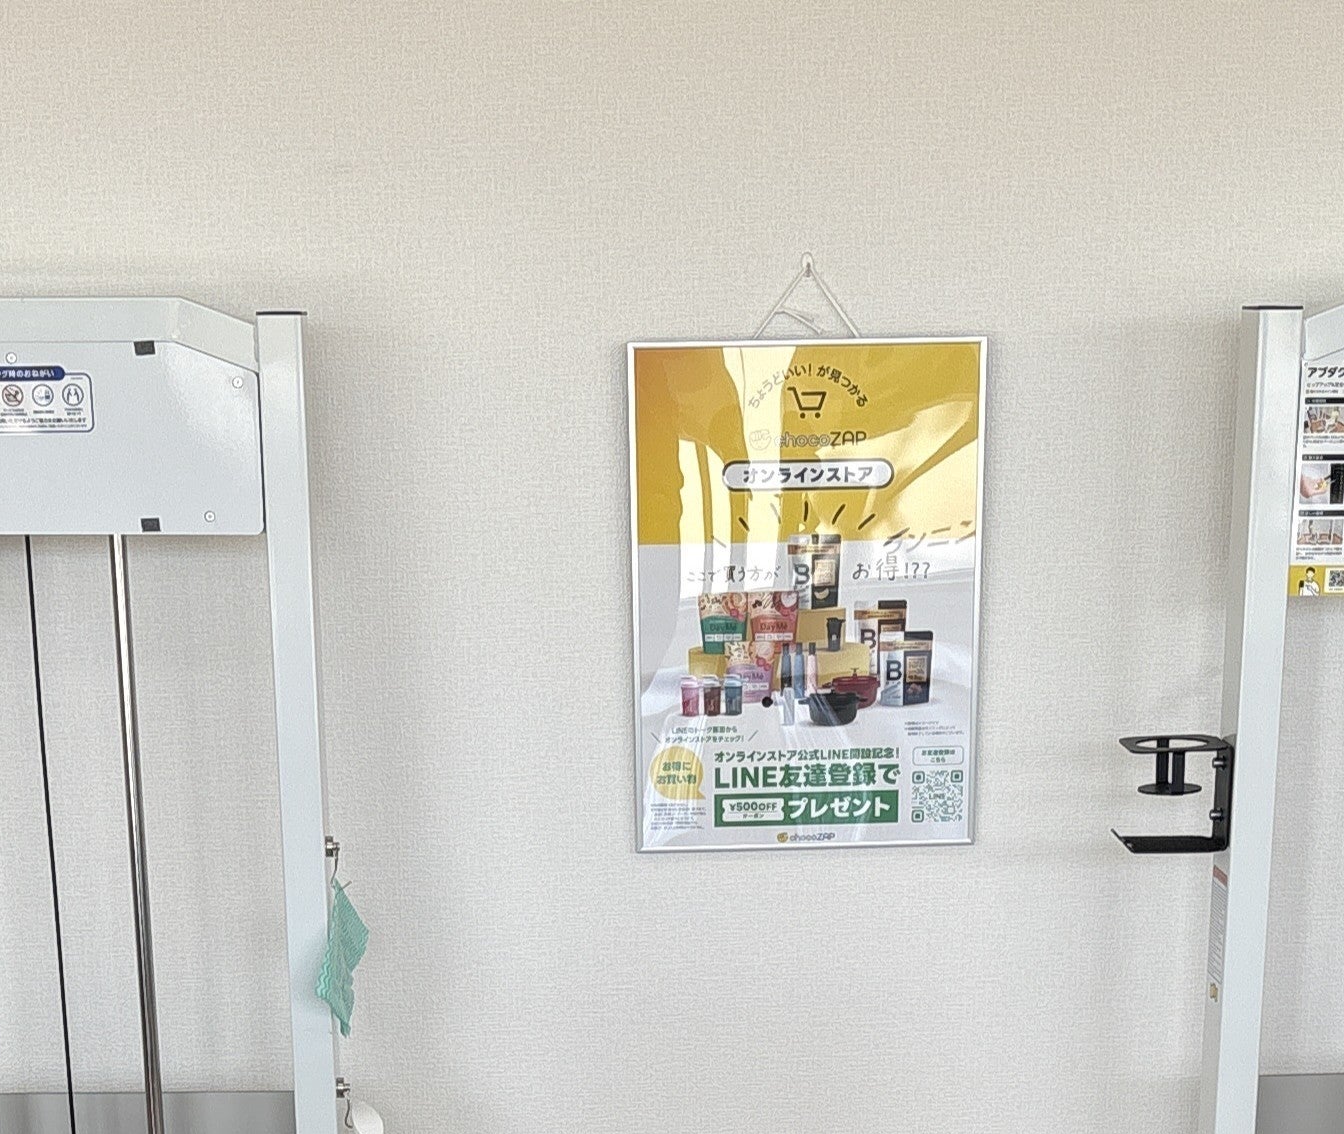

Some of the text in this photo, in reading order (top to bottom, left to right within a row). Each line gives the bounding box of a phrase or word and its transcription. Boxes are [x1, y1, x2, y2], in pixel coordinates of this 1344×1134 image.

[776, 431, 867, 447] chocoZAP
[743, 465, 873, 484] オンラインストア
[886, 660, 902, 681] B
[714, 747, 899, 763] オンラインストア公式LINE開設記念！
[662, 761, 692, 772] お得に
[714, 763, 901, 789] LINE友達登録で
[788, 797, 891, 820] プレゼント
